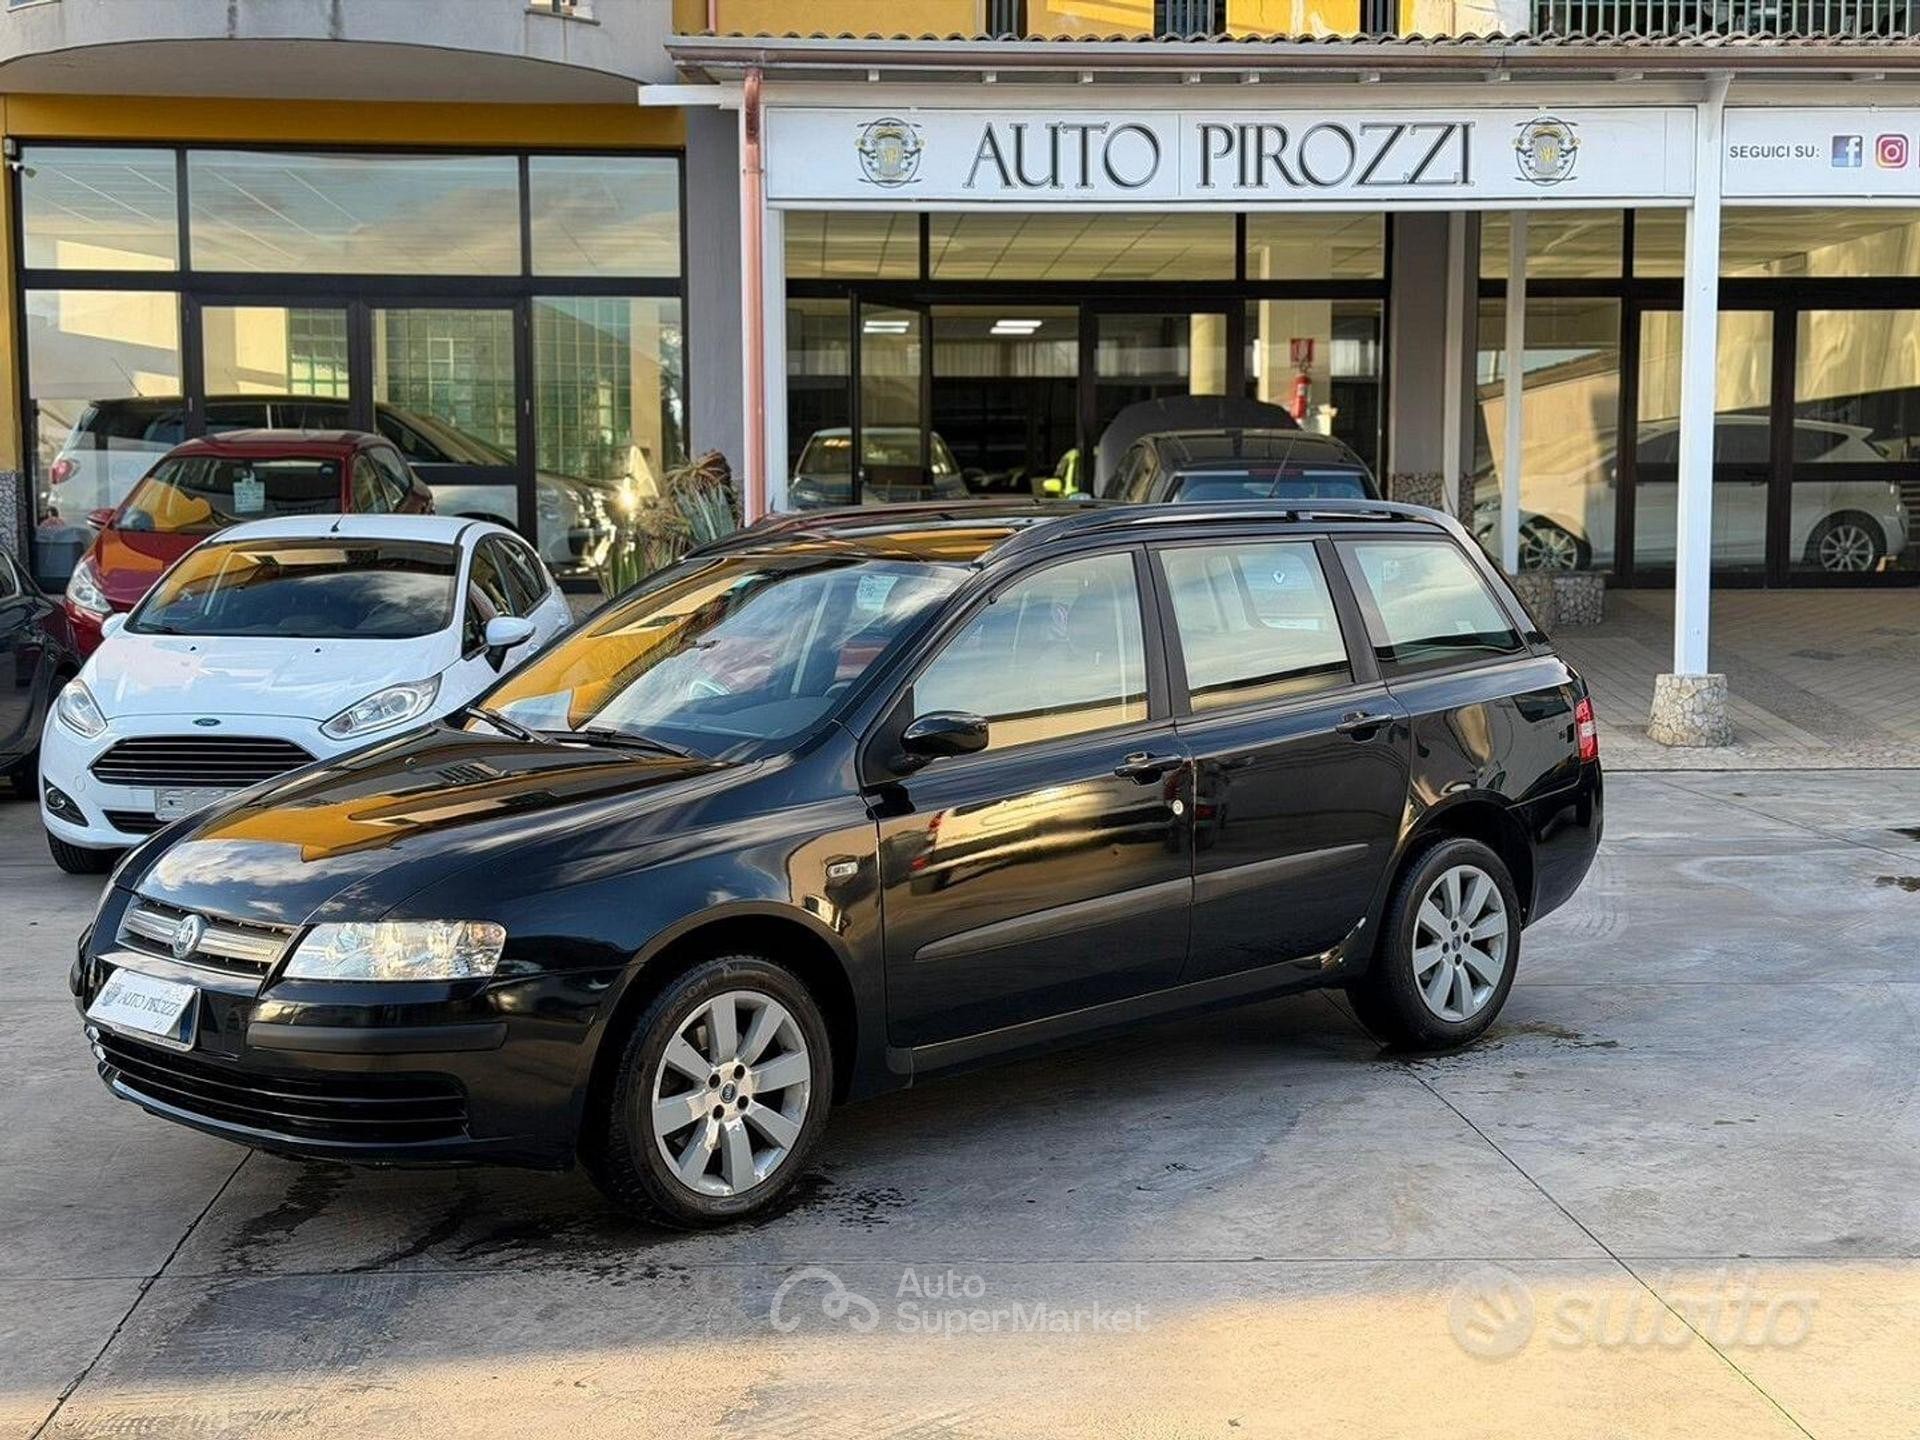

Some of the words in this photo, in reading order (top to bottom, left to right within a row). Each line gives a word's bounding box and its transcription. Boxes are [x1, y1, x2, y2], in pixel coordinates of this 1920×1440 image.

[962, 121, 1161, 190] AUTO
[1196, 120, 1476, 189] PIROZZI
[1729, 145, 1790, 159] SEGUICI
[1794, 145, 1821, 159] SU:
